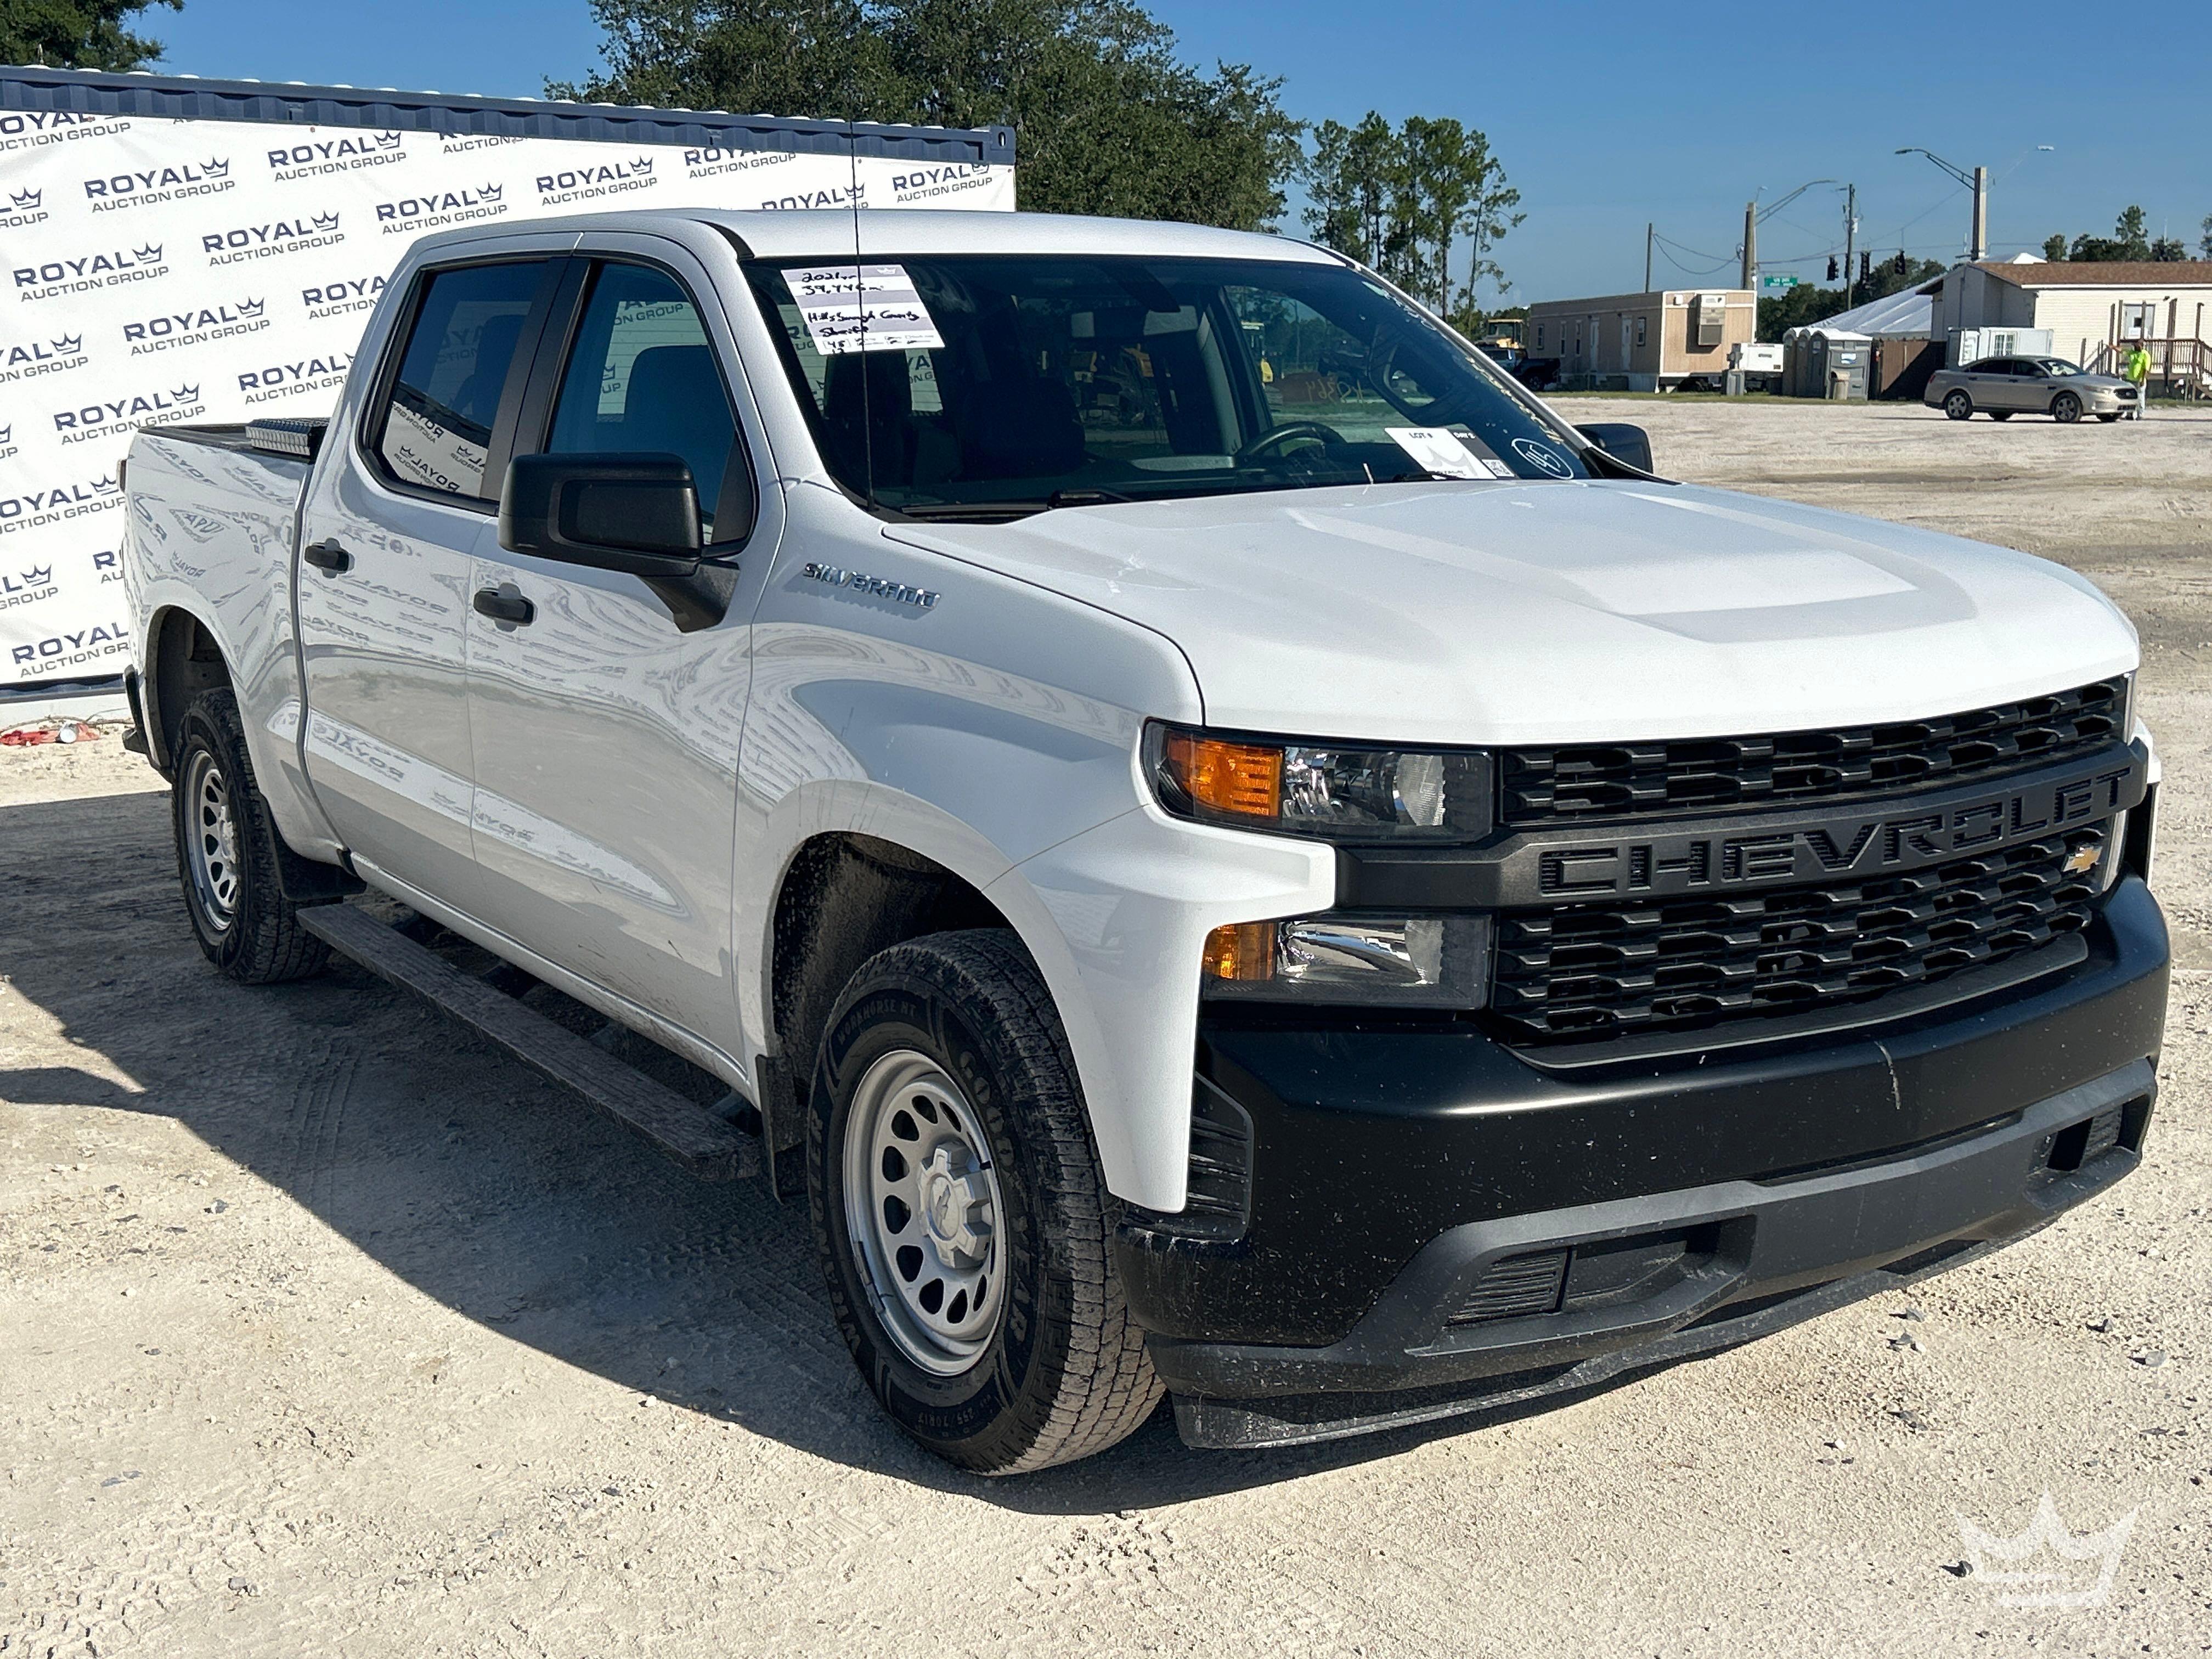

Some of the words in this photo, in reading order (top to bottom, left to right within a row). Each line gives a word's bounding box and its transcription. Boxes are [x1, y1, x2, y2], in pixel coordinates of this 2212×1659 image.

[1, 112, 87, 134] OYAL
[67, 122, 131, 140] GROUP
[268, 137, 376, 168] ROYAL
[274, 161, 347, 182] AUCTION
[351, 152, 407, 169] GROUP
[689, 161, 748, 179] AUCTION
[751, 153, 796, 167] GROUP
[84, 165, 201, 199] ROYAL
[536, 163, 631, 193] ROYAL
[542, 187, 606, 206] AUCTION
[608, 177, 658, 194] GROUP
[892, 165, 970, 191] ROYAL
[897, 185, 950, 203] AUCTION
[952, 177, 992, 192] GROUP
[92, 190, 171, 213] AUCTION
[175, 180, 235, 199] GROUP
[376, 190, 478, 221] ROYAL
[0, 212, 48, 228] ROUP
[202, 219, 313, 252] ROYAL
[383, 215, 452, 235] AUCTION
[455, 205, 507, 222] GROUP
[210, 245, 284, 267] AUCTION
[288, 234, 345, 251] GROUP
[13, 252, 134, 287] ROYAL
[21, 278, 103, 302] AUCTION
[107, 266, 169, 286] GROUP
[302, 276, 387, 306] ROYA
[123, 306, 238, 342] ROYAL
[636, 303, 684, 321] GROUP
[131, 332, 207, 356] AUCTION
[211, 319, 270, 340] GROUP
[24, 356, 88, 377] GROUP
[238, 356, 347, 391] ROYAL
[245, 380, 318, 405] AUCTION
[54, 393, 172, 431] ROYAL
[61, 419, 142, 445] AUCTION
[145, 405, 206, 427] GROUP
[1, 484, 92, 518] OYAL
[803, 562, 942, 611] SILVERADO
[12, 622, 129, 664] ROYAL
[20, 648, 100, 678] AUCTION
[1538, 766, 2132, 898] CHEVROLET
